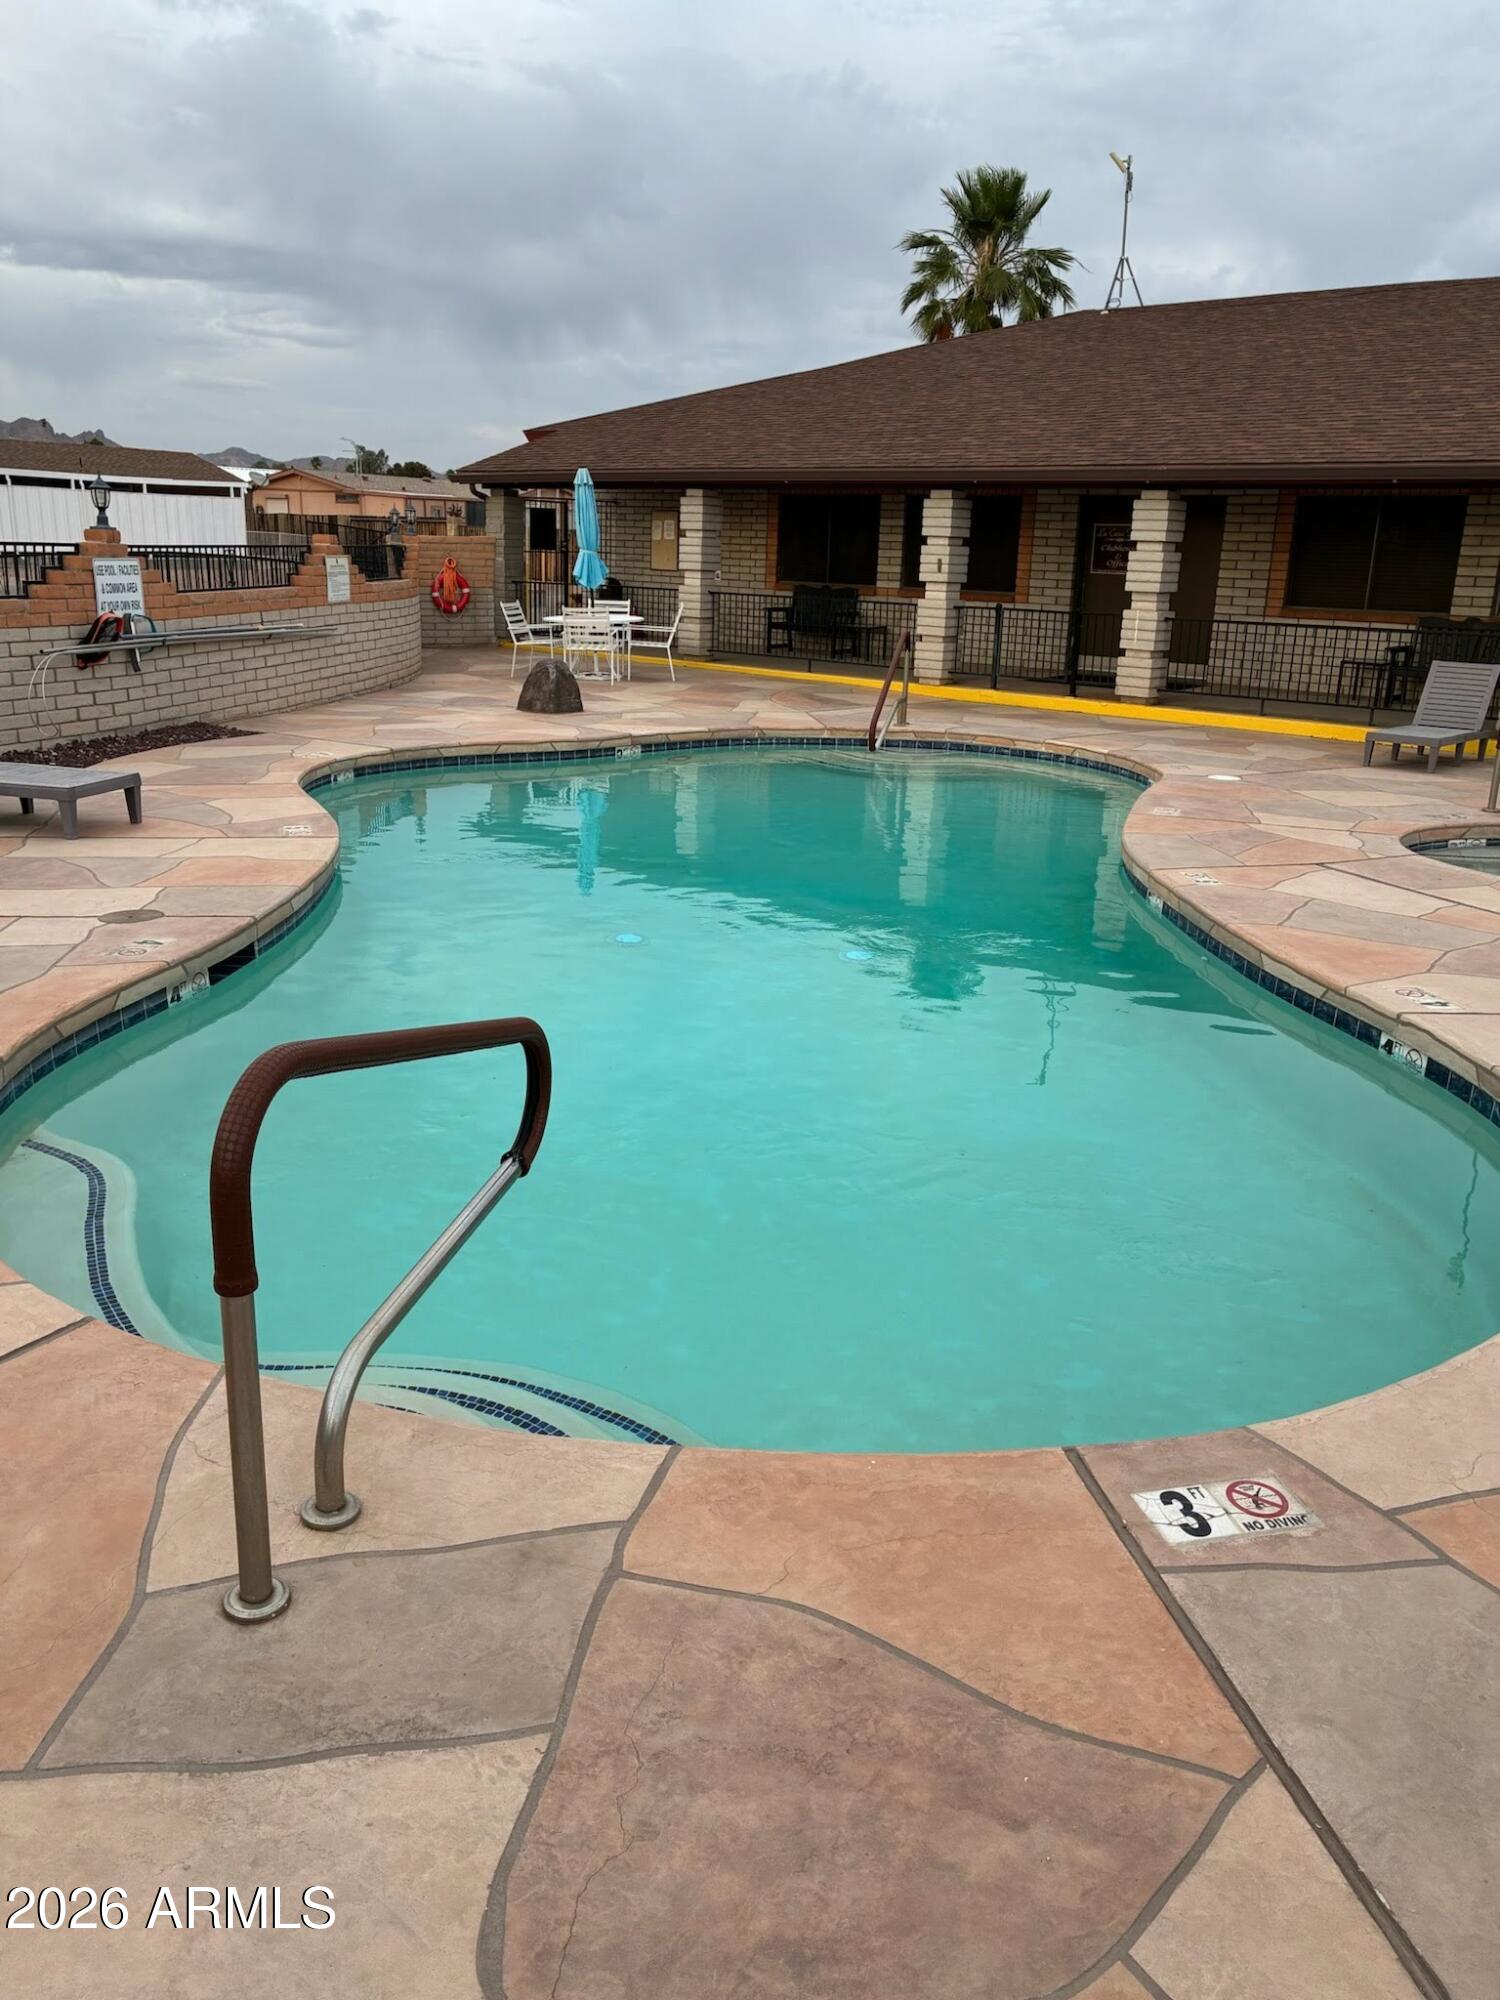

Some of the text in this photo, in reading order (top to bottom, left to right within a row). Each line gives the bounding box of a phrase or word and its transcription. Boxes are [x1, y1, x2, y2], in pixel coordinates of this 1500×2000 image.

[104, 565, 117, 576] POOL
[105, 583, 126, 594] COMMON
[127, 582, 138, 593] AREA
[107, 601, 119, 611] YOUR
[120, 601, 131, 611] OWN
[131, 600, 142, 610] RISK
[170, 985, 182, 1004] 4
[1381, 1038, 1394, 1056] 4
[1159, 1486, 1212, 1537] 3 FT
[1242, 1520, 1265, 1532] NO
